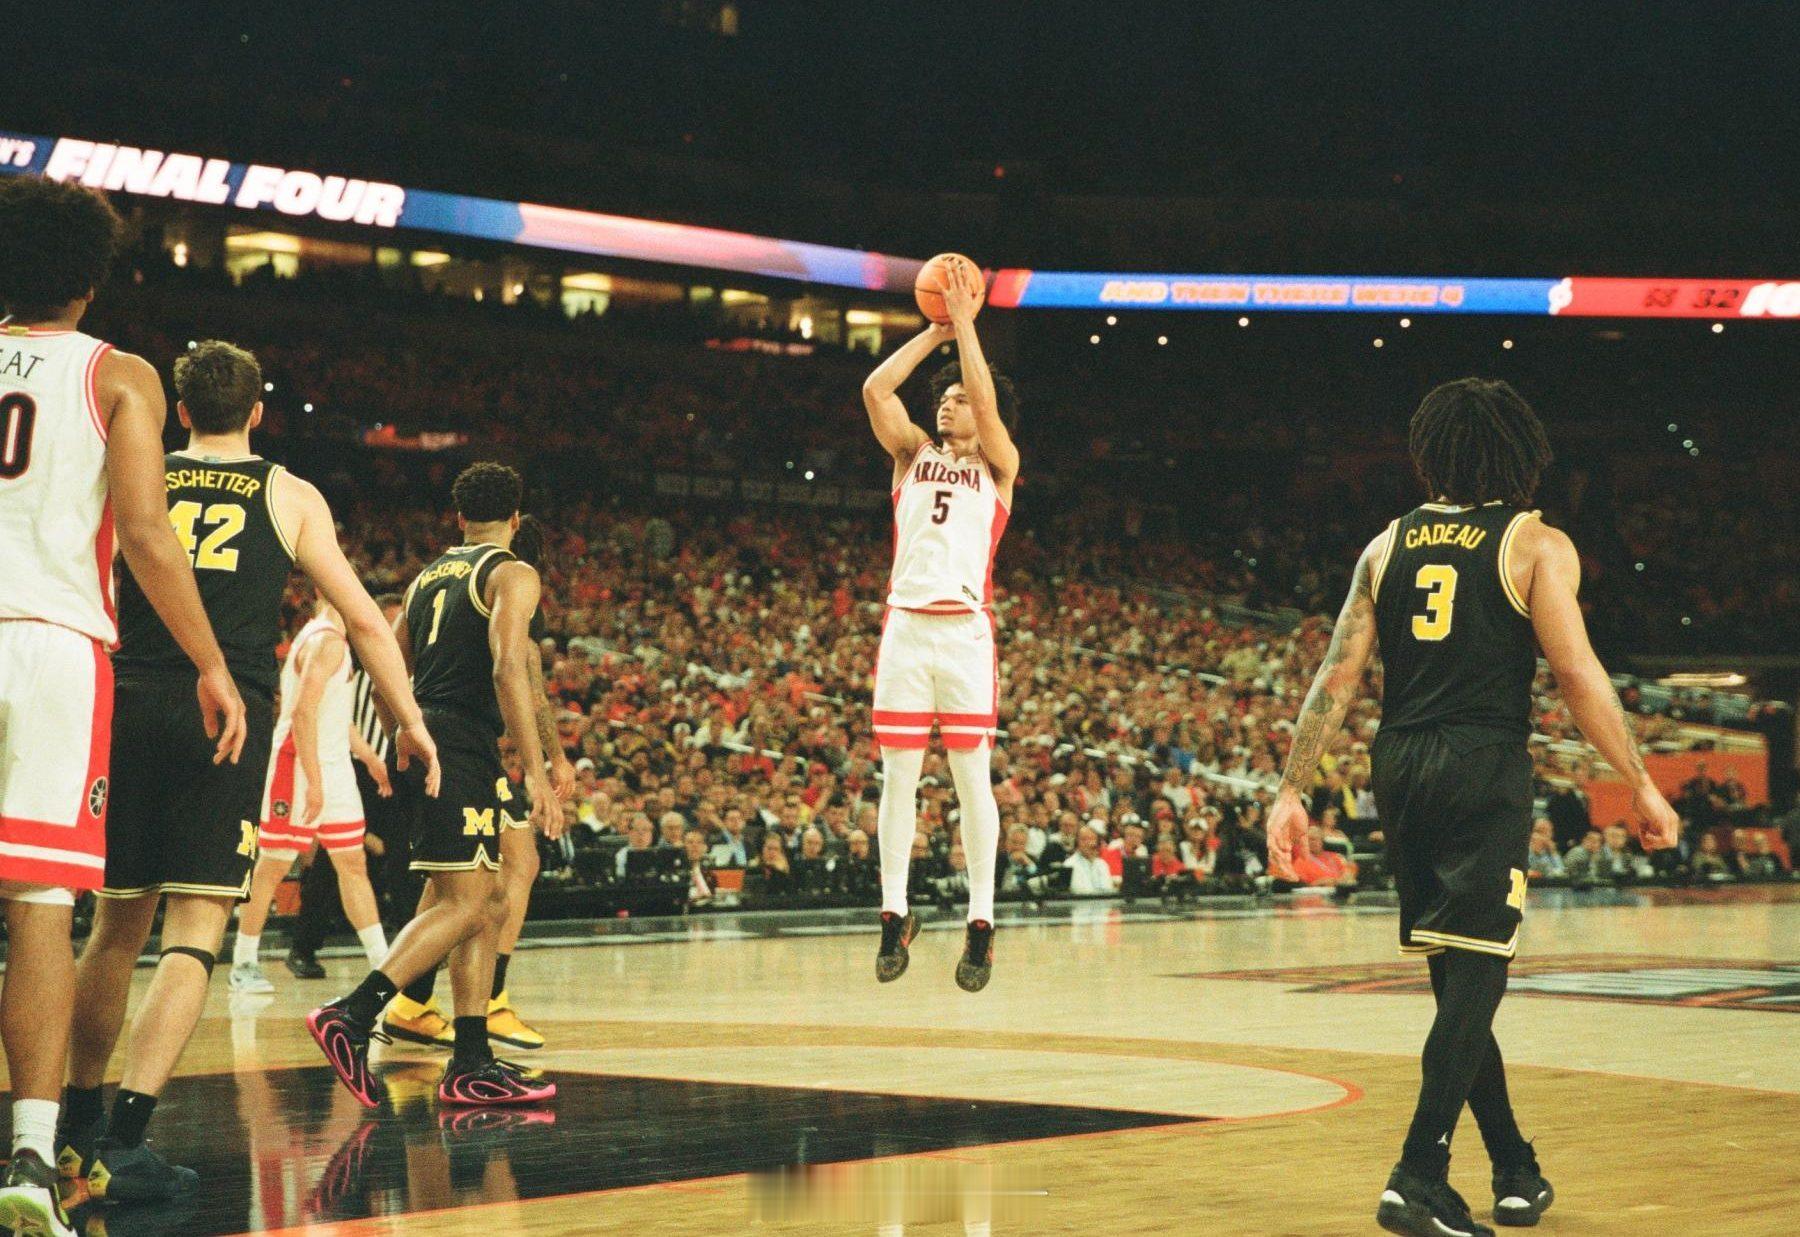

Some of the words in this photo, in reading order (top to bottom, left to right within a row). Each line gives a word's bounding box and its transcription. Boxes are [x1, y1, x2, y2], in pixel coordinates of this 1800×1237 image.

[45, 137, 232, 204] FINAL
[235, 165, 406, 227] FOUR
[0, 391, 36, 480] 0
[166, 469, 261, 498] SCHETTER
[914, 461, 981, 494] ARIZONA
[931, 490, 953, 525] 5
[167, 500, 246, 572] 42
[1405, 523, 1487, 549] CADEAU
[427, 589, 447, 646] 1
[1411, 564, 1459, 642] 3
[463, 807, 495, 836] M
